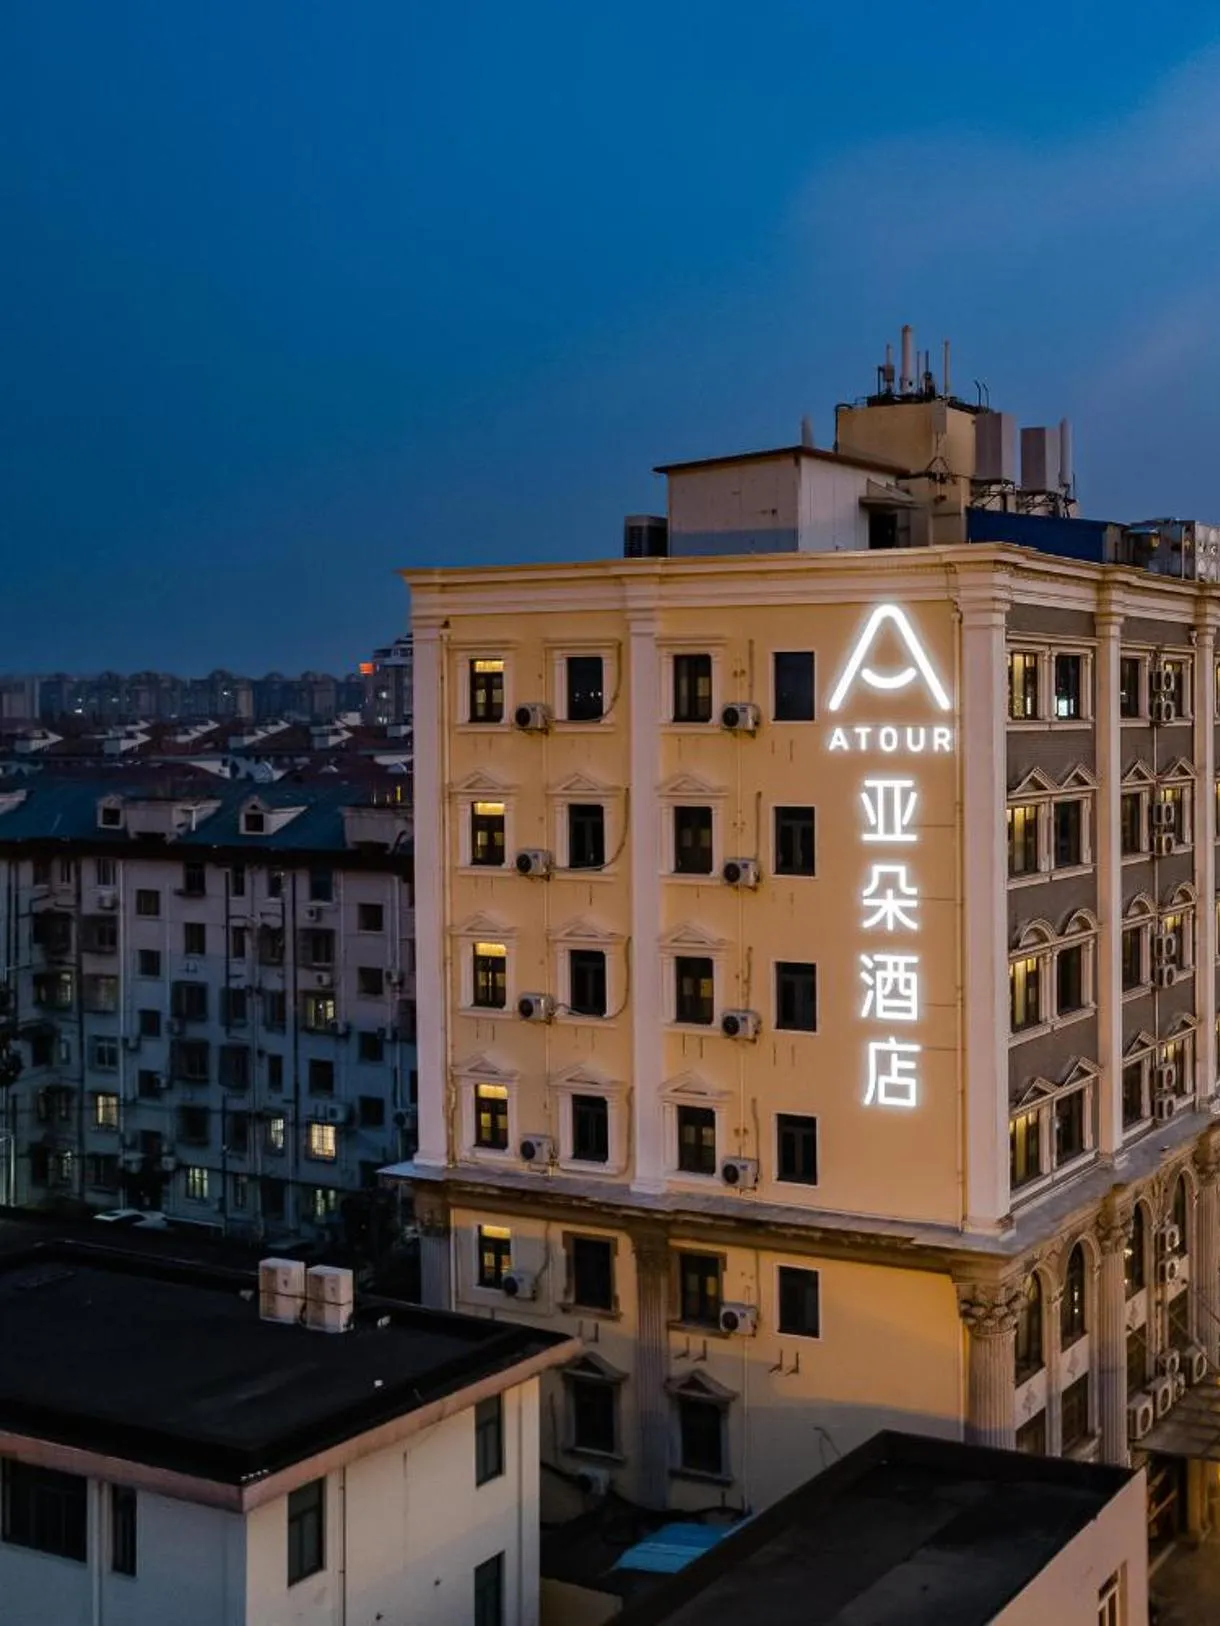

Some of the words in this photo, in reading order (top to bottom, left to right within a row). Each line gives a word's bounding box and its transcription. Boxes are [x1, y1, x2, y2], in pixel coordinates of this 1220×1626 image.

[828, 726, 952, 752] ATOUR
[860, 779, 922, 1108] 亚朵酒店
